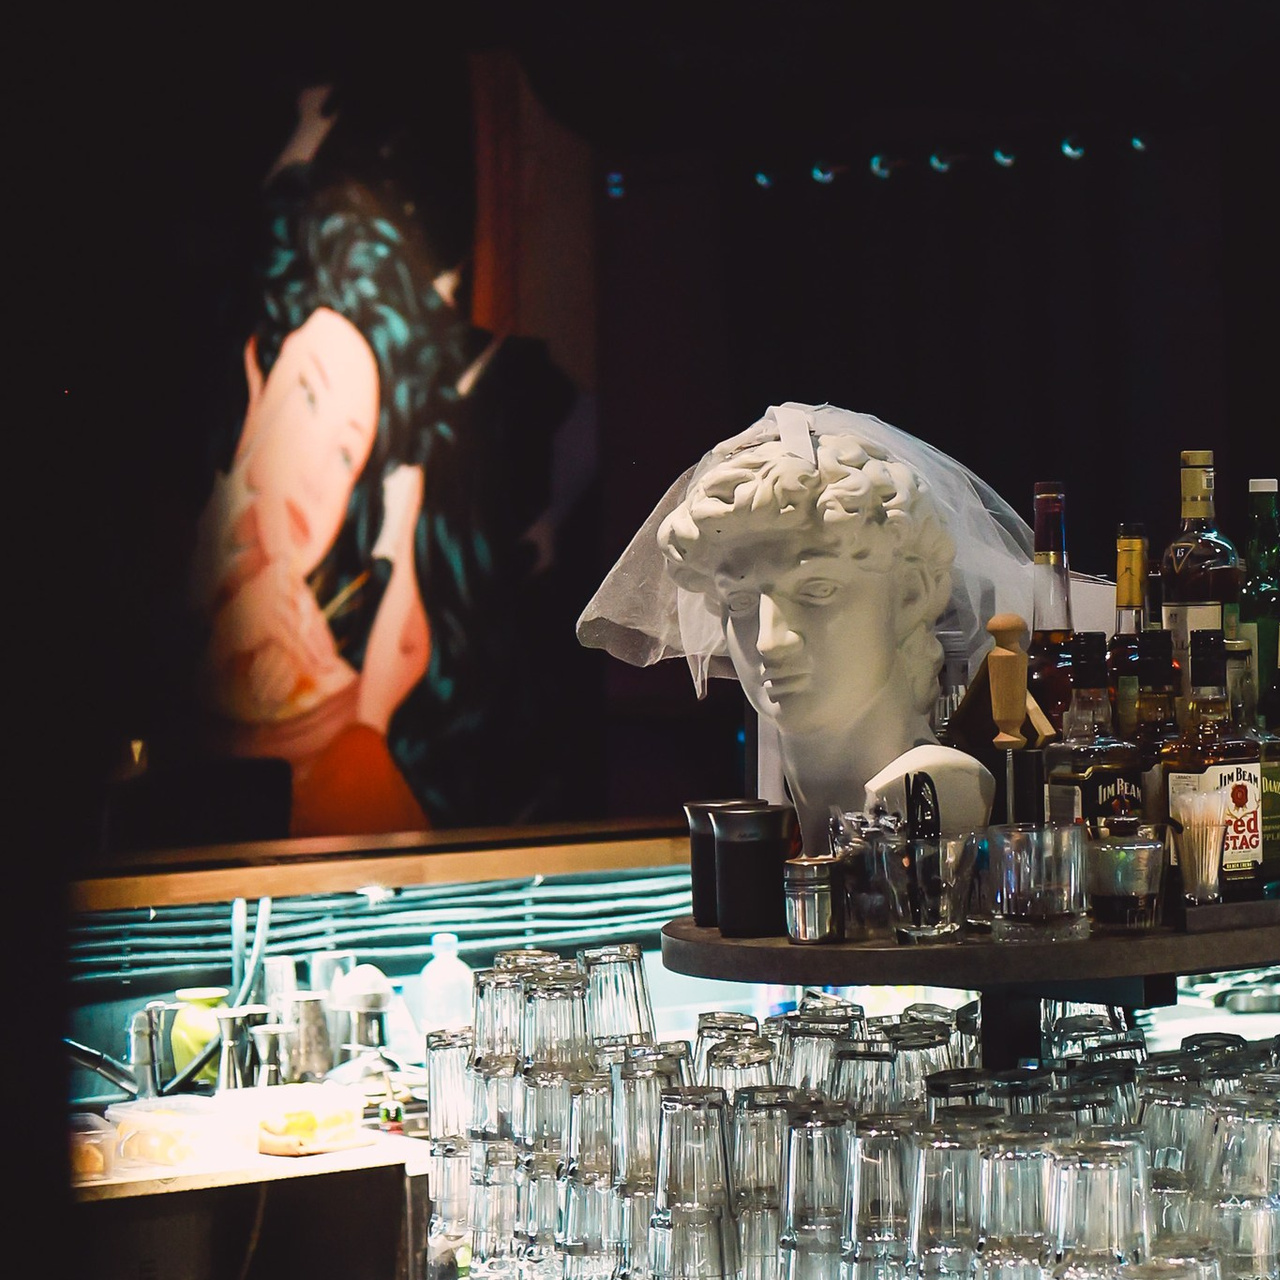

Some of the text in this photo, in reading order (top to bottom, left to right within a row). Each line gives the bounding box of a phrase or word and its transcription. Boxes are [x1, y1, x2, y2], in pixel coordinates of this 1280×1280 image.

[1219, 767, 1259, 788] JIM BEAM
[1098, 783, 1115, 806] JIM
[1225, 810, 1258, 835] red
